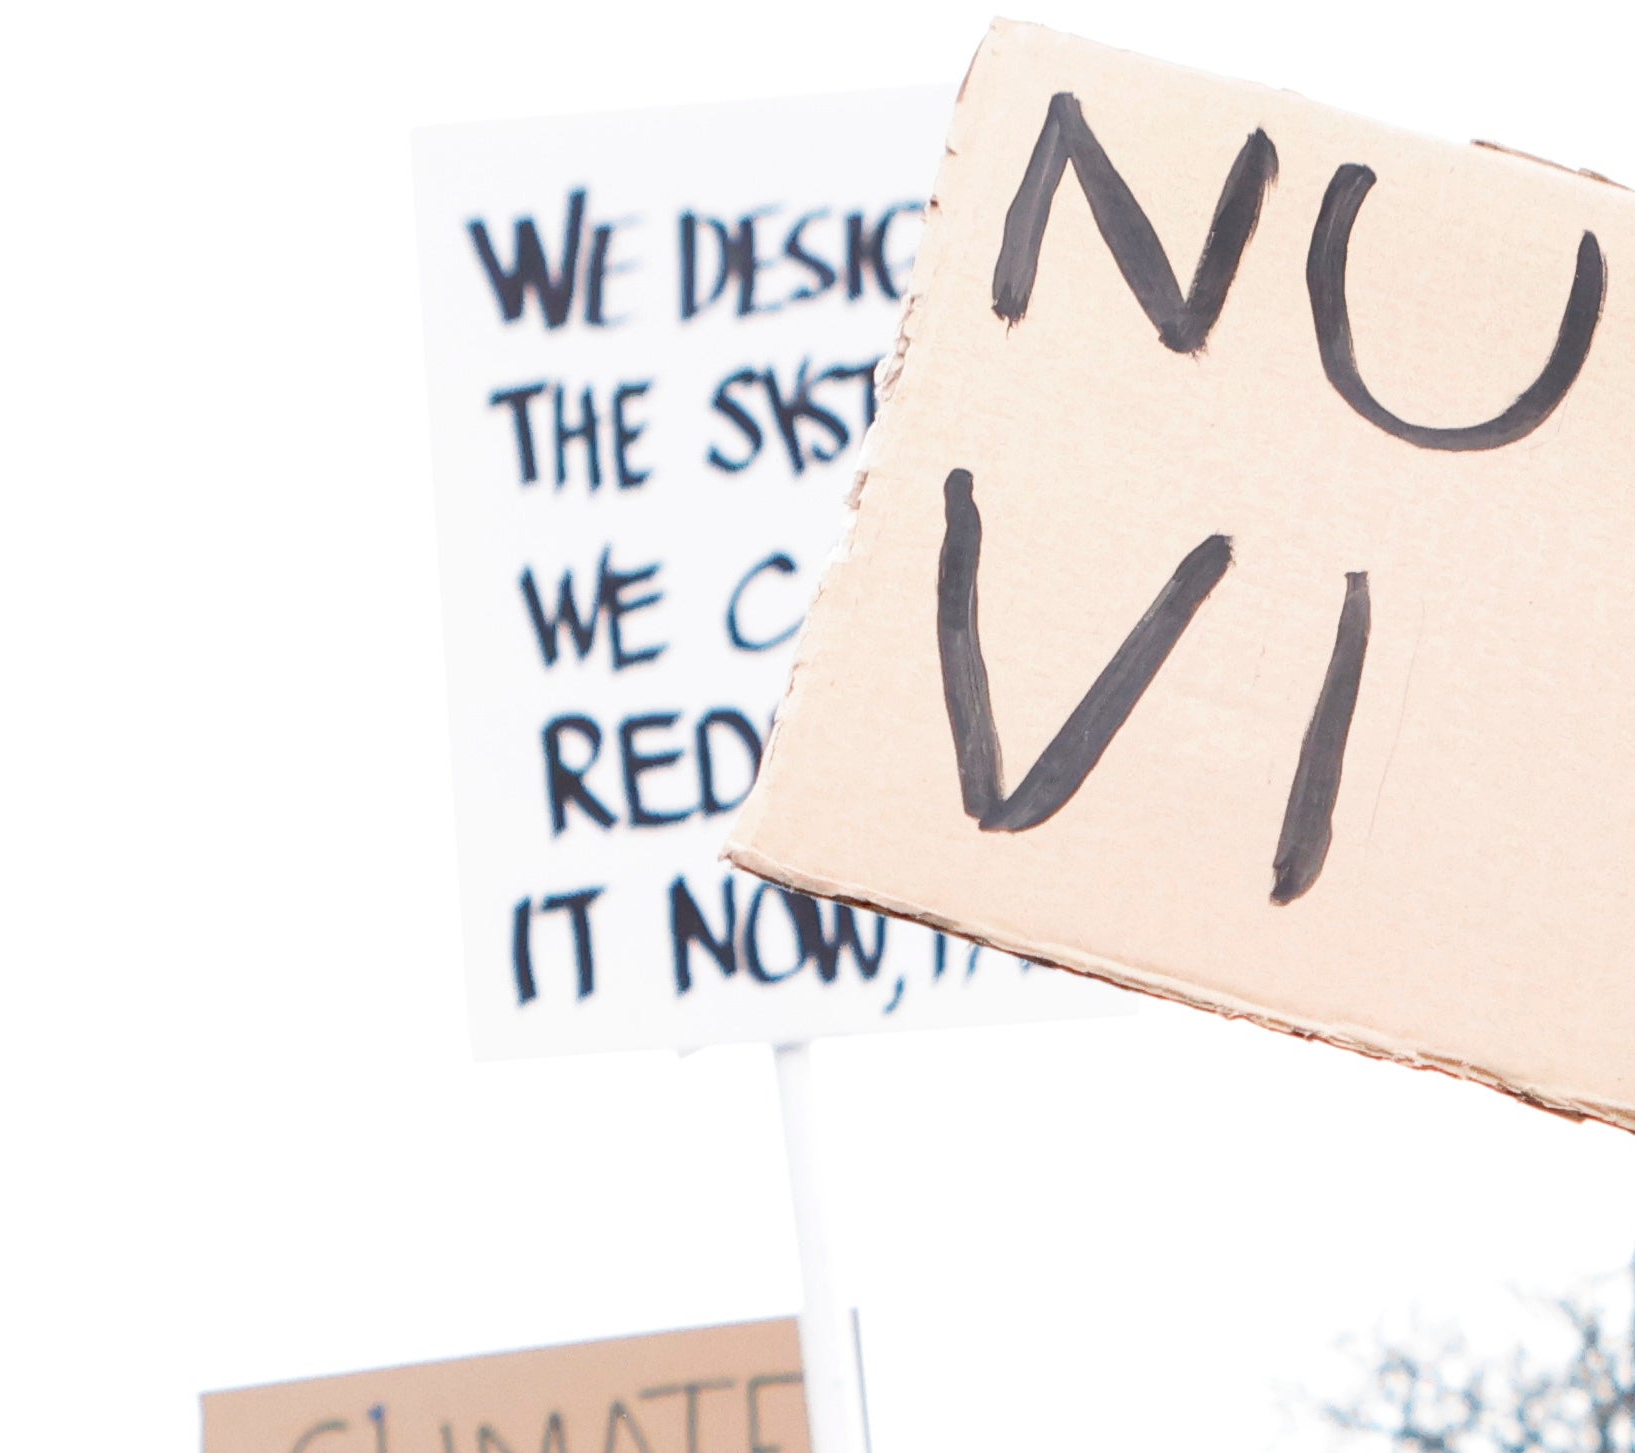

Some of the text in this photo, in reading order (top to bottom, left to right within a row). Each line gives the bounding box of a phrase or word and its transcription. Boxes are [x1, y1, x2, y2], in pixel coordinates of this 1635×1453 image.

[466, 187, 637, 332] WE
[993, 92, 1605, 452] NU
[488, 381, 657, 494] THE
[519, 545, 668, 672] WE
[937, 467, 1369, 907] VI
[542, 706, 773, 838] RED
[511, 888, 603, 1005] IT
